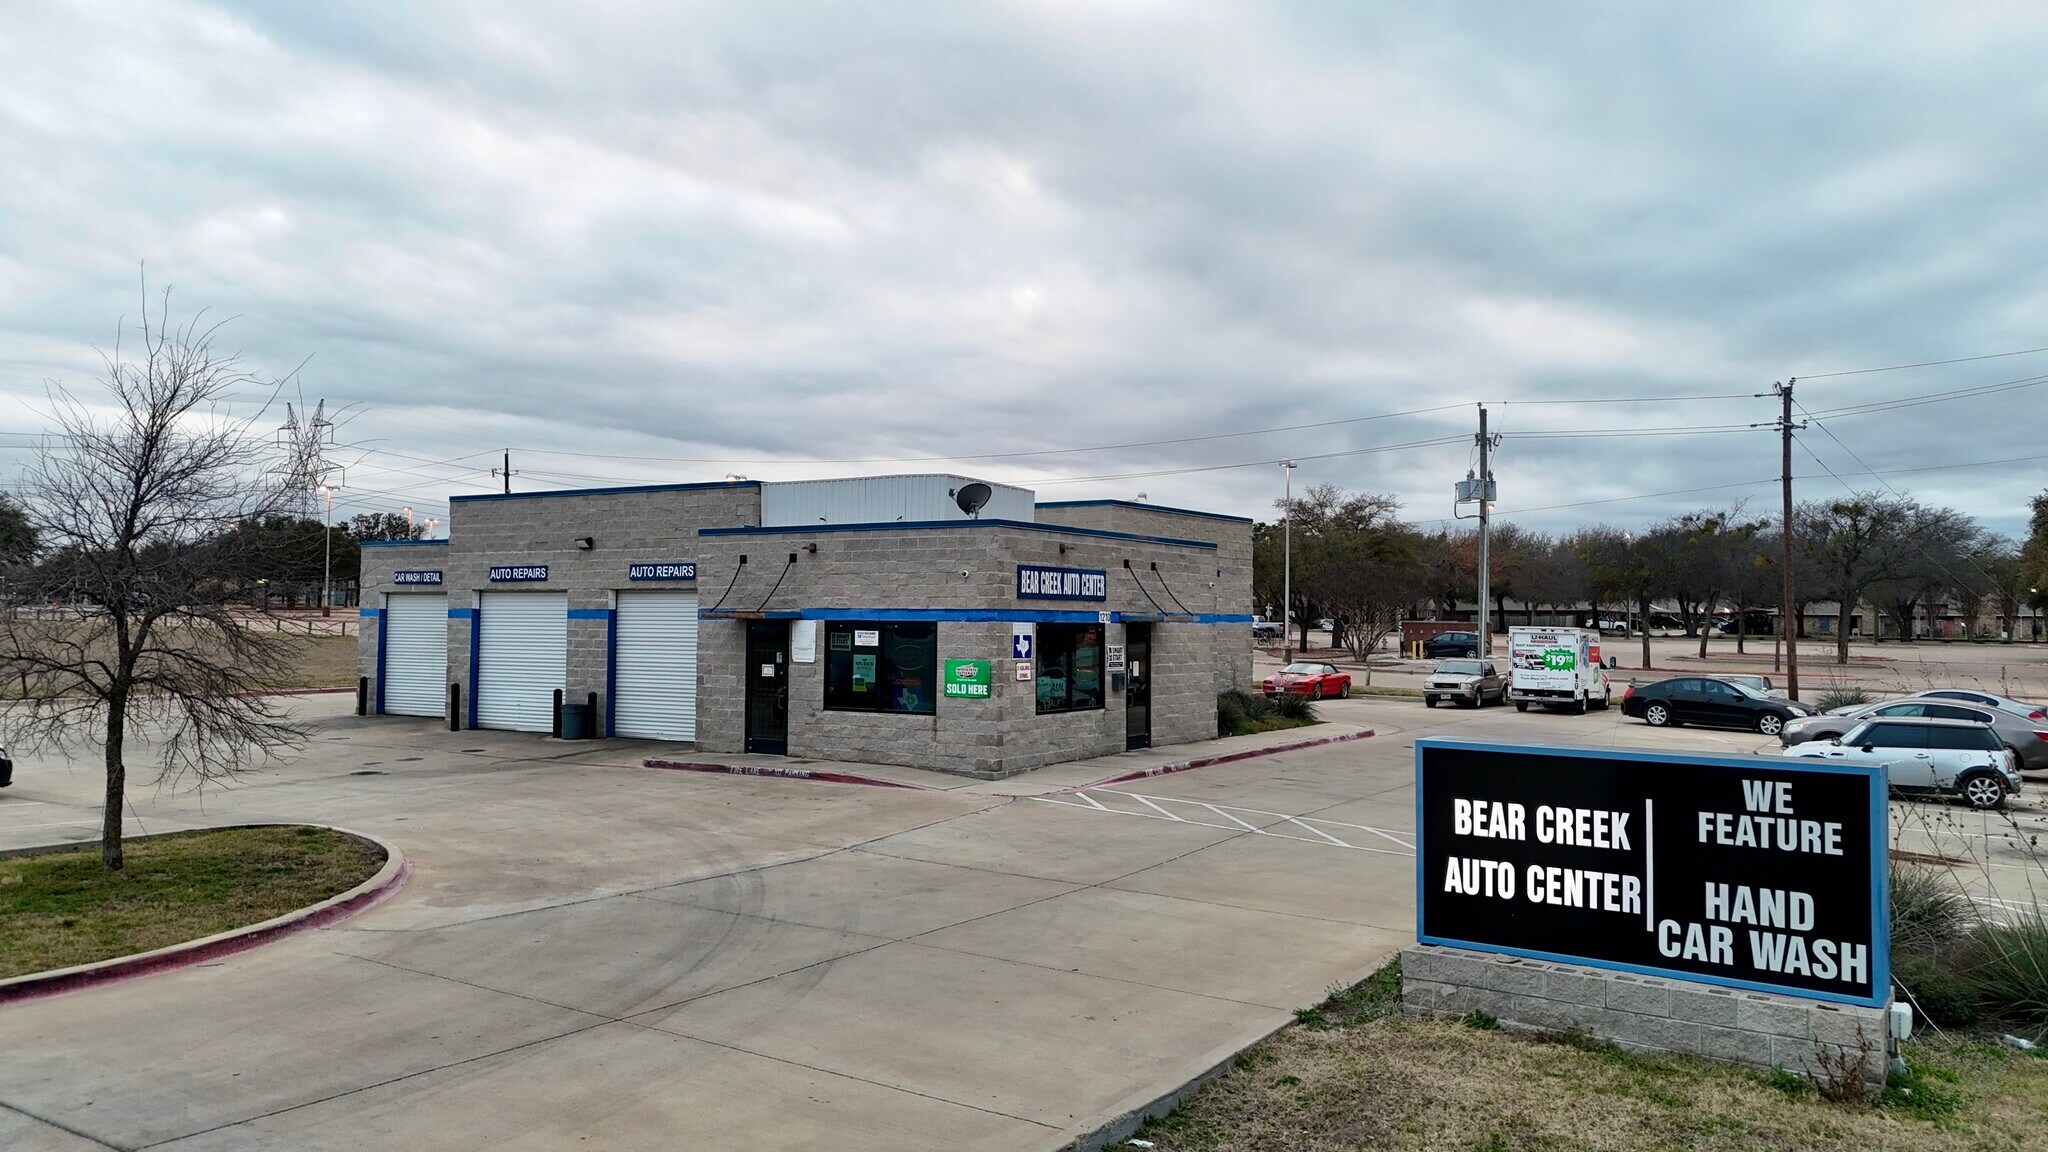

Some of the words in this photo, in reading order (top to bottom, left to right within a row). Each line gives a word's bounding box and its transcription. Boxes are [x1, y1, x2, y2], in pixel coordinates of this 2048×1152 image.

[394, 573, 405, 582] CAR
[405, 573, 420, 582] WASH
[423, 572, 441, 582] DETAIL
[490, 569, 511, 580] AUTO
[512, 568, 547, 579] REPAIRS
[630, 566, 654, 578] AUTO
[656, 566, 694, 577] REPAIRS
[1021, 570, 1039, 594] BEAR
[1040, 571, 1062, 595] CREEK
[1063, 572, 1080, 596] AUTO
[1081, 573, 1105, 597] CENTER
[946, 684, 966, 694] SOLD
[968, 684, 988, 695] HERE
[1741, 779, 1794, 815] WE
[1454, 798, 1526, 841] BEAR
[1535, 805, 1631, 851] CREEK
[1698, 811, 1844, 856] FEATURE
[1444, 856, 1516, 899] AUTO
[1526, 864, 1641, 915] CENTER
[1705, 881, 1815, 932] HAND
[1658, 919, 1733, 966] CAR
[1748, 930, 1867, 984] WASH
